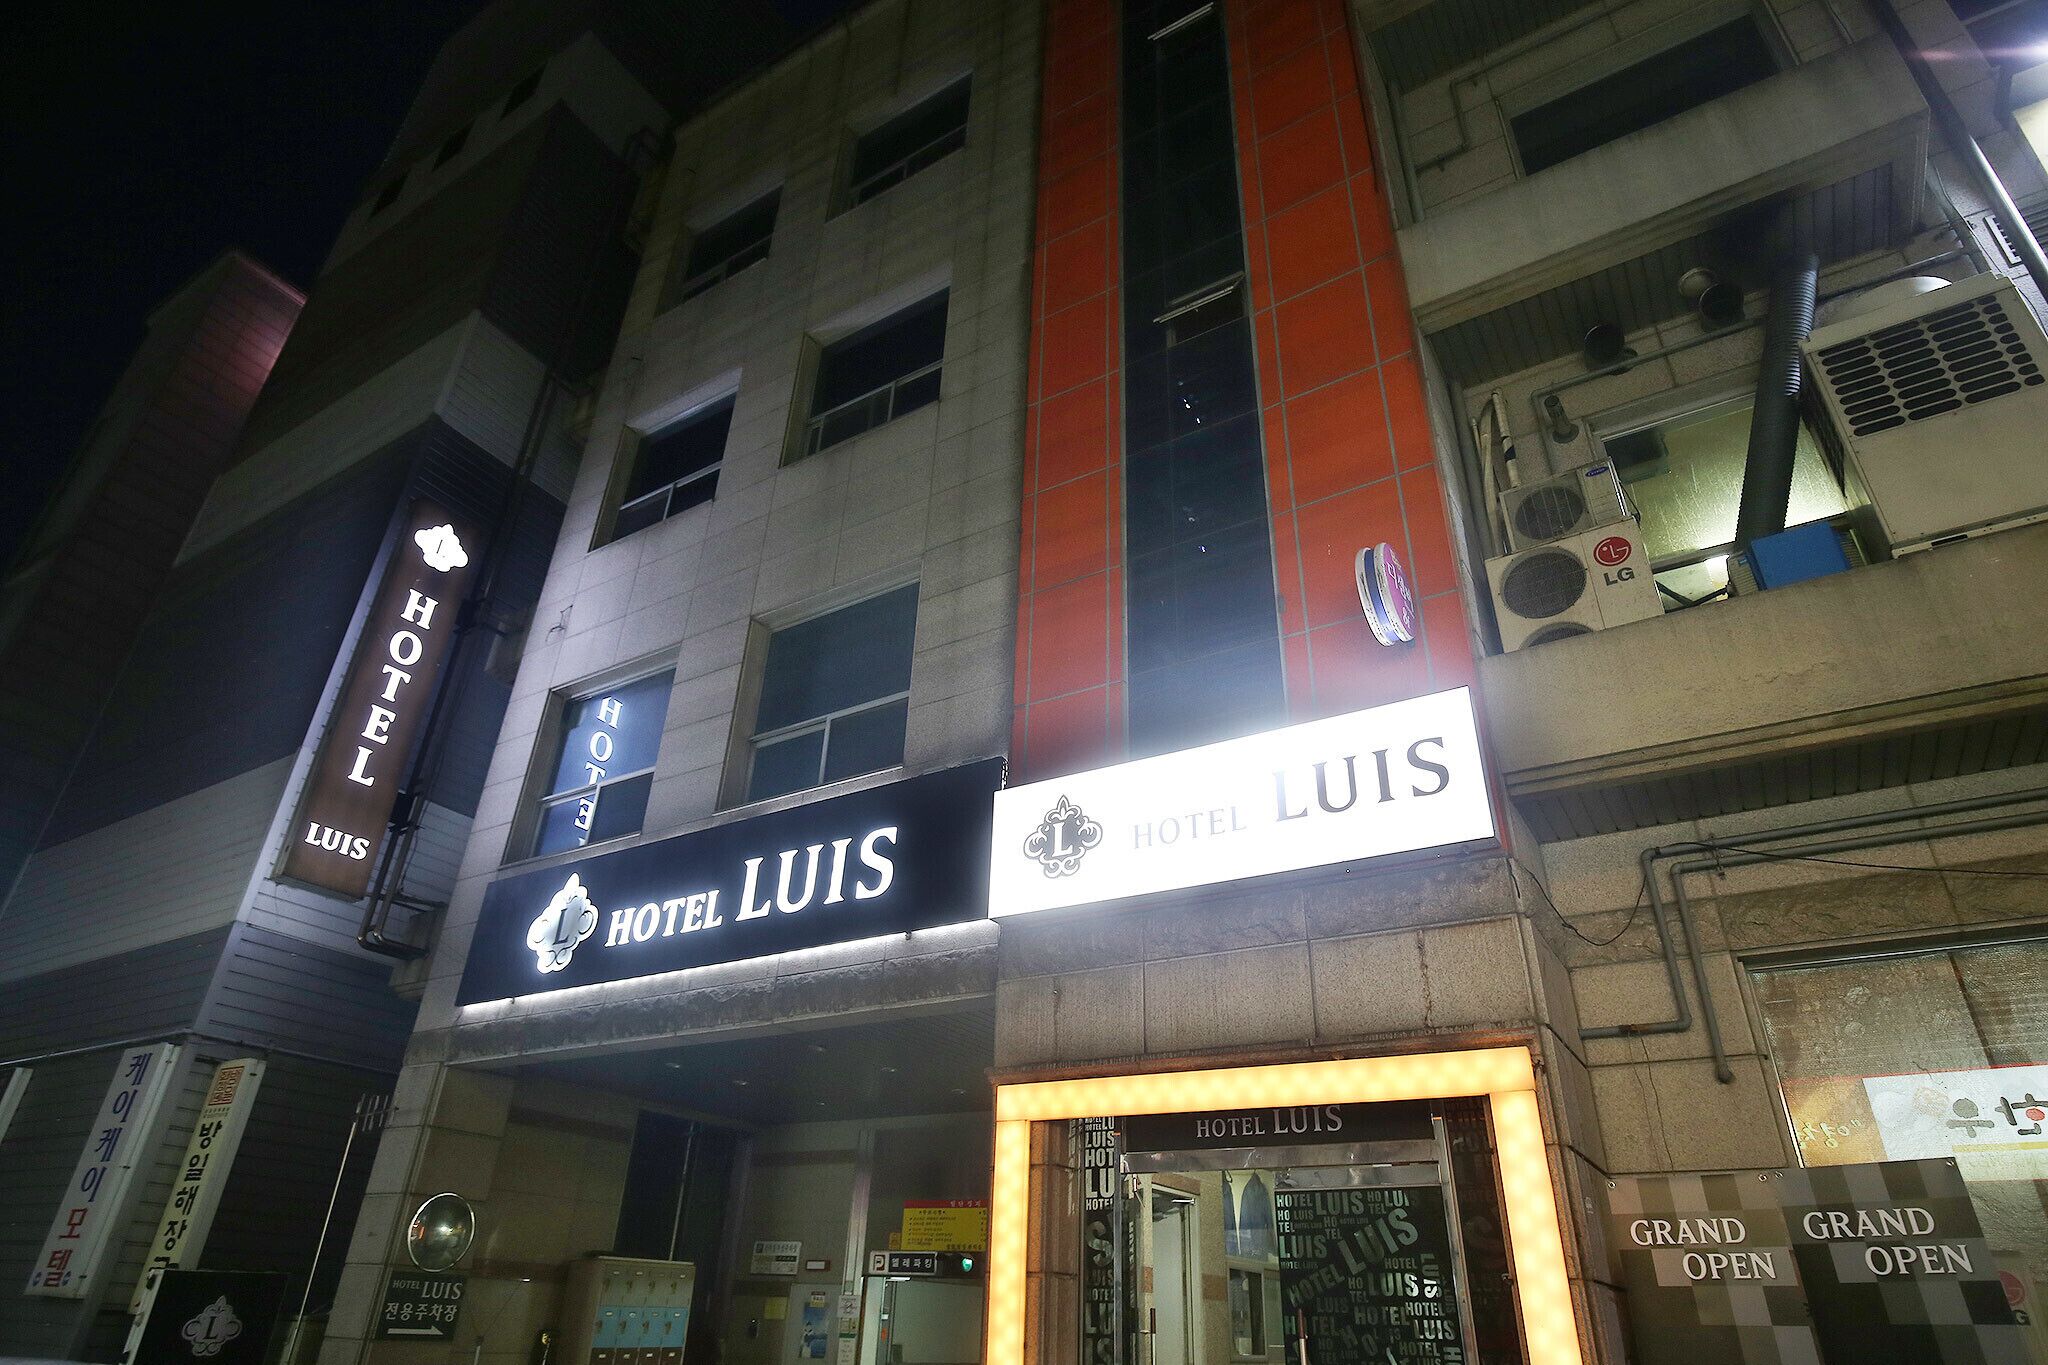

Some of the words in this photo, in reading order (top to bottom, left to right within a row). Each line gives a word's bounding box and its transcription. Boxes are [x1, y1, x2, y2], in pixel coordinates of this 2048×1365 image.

[1603, 567, 1636, 587] LG
[348, 588, 439, 787] HOTEL
[1133, 805, 1248, 850] HOTEL
[1272, 736, 1450, 823] LUIS
[304, 821, 371, 862] LUIS
[604, 889, 724, 948] HOTEL
[735, 826, 899, 923] LUIS
[1196, 1116, 1266, 1139] HOTEL
[1272, 1105, 1344, 1135] LUIS
[1085, 1131, 1115, 1148] LUIS
[1276, 1194, 1313, 1208] HOTEL
[1315, 1191, 1365, 1215] LUIS
[1630, 1217, 1747, 1246] GRAND
[1803, 1207, 1936, 1241] GRAND
[1279, 1235, 1328, 1258] LUIS
[1337, 1207, 1419, 1275] LUIS
[1384, 1258, 1417, 1269] HOTEL
[1682, 1252, 1778, 1281] OPEN
[1864, 1244, 1974, 1276] OPEN
[392, 1280, 420, 1289] HOTEL
[422, 1281, 463, 1300] LUIS
[1367, 1272, 1419, 1297] LUIS
[385, 1302, 458, 1322] 전용주차장
[1404, 1302, 1445, 1316] HOTEL
[1414, 1320, 1456, 1340] LUIS
